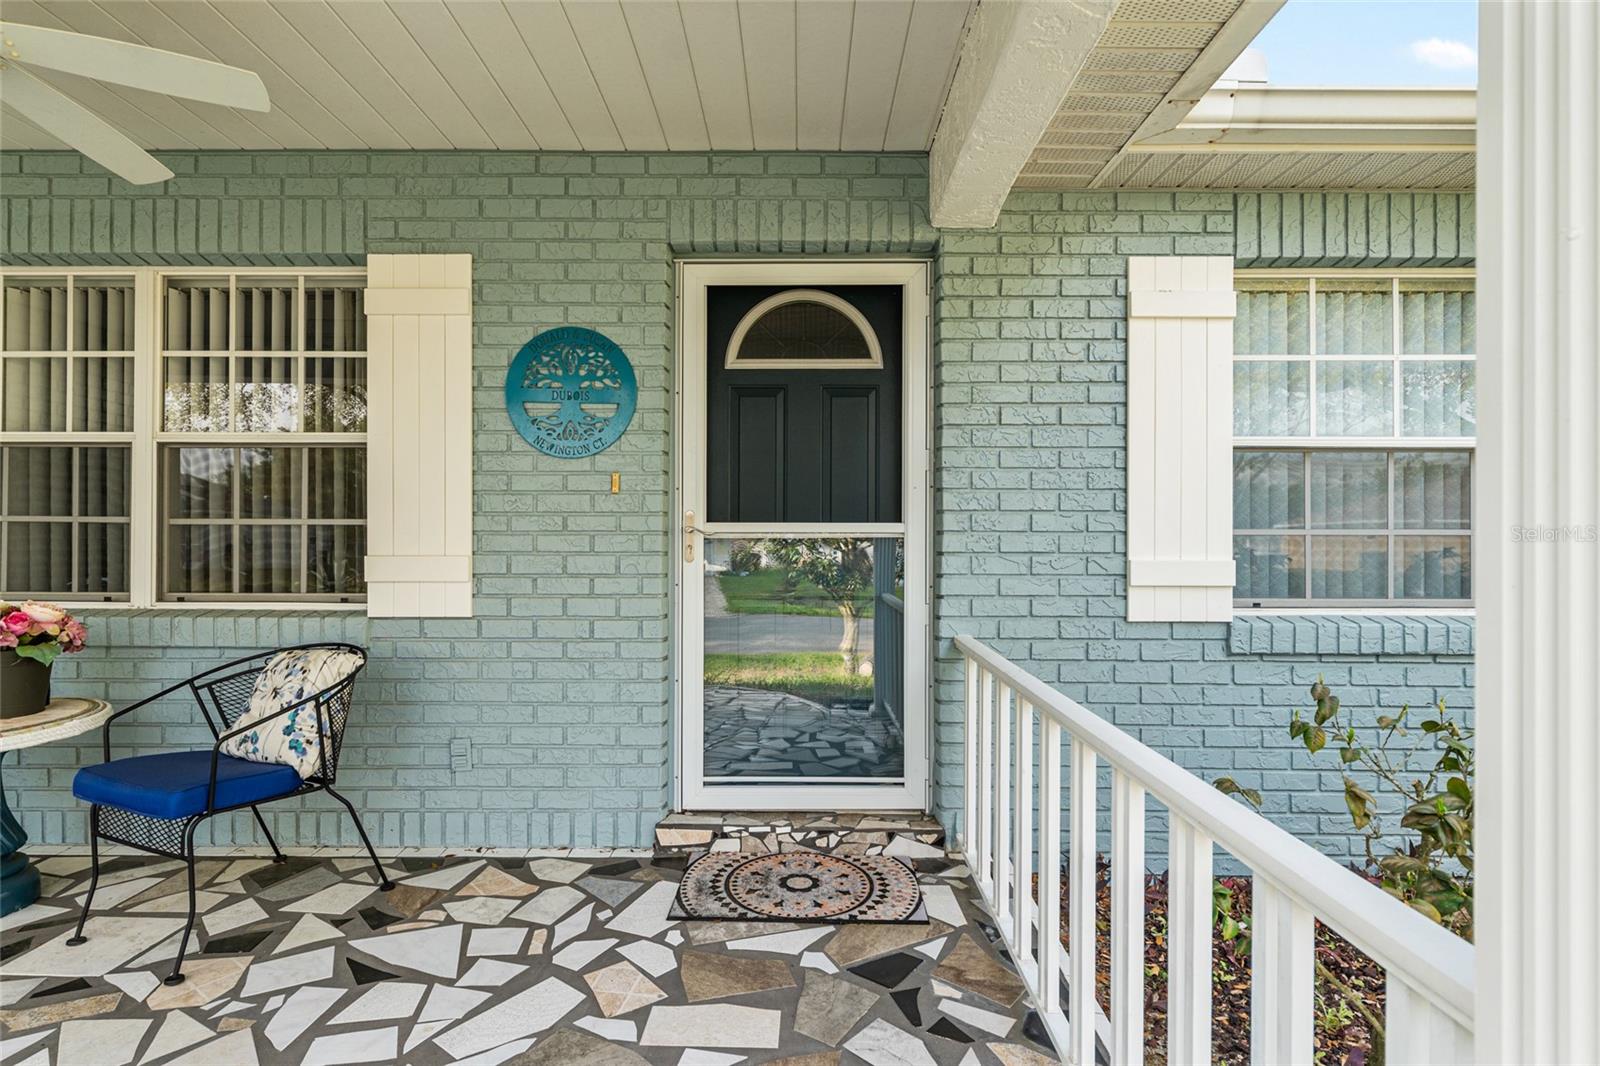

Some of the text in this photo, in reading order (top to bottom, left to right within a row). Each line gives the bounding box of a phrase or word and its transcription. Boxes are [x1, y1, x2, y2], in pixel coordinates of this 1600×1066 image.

[551, 390, 591, 402] DUBOIS
[532, 435, 608, 456] NEWINGTON CT.
